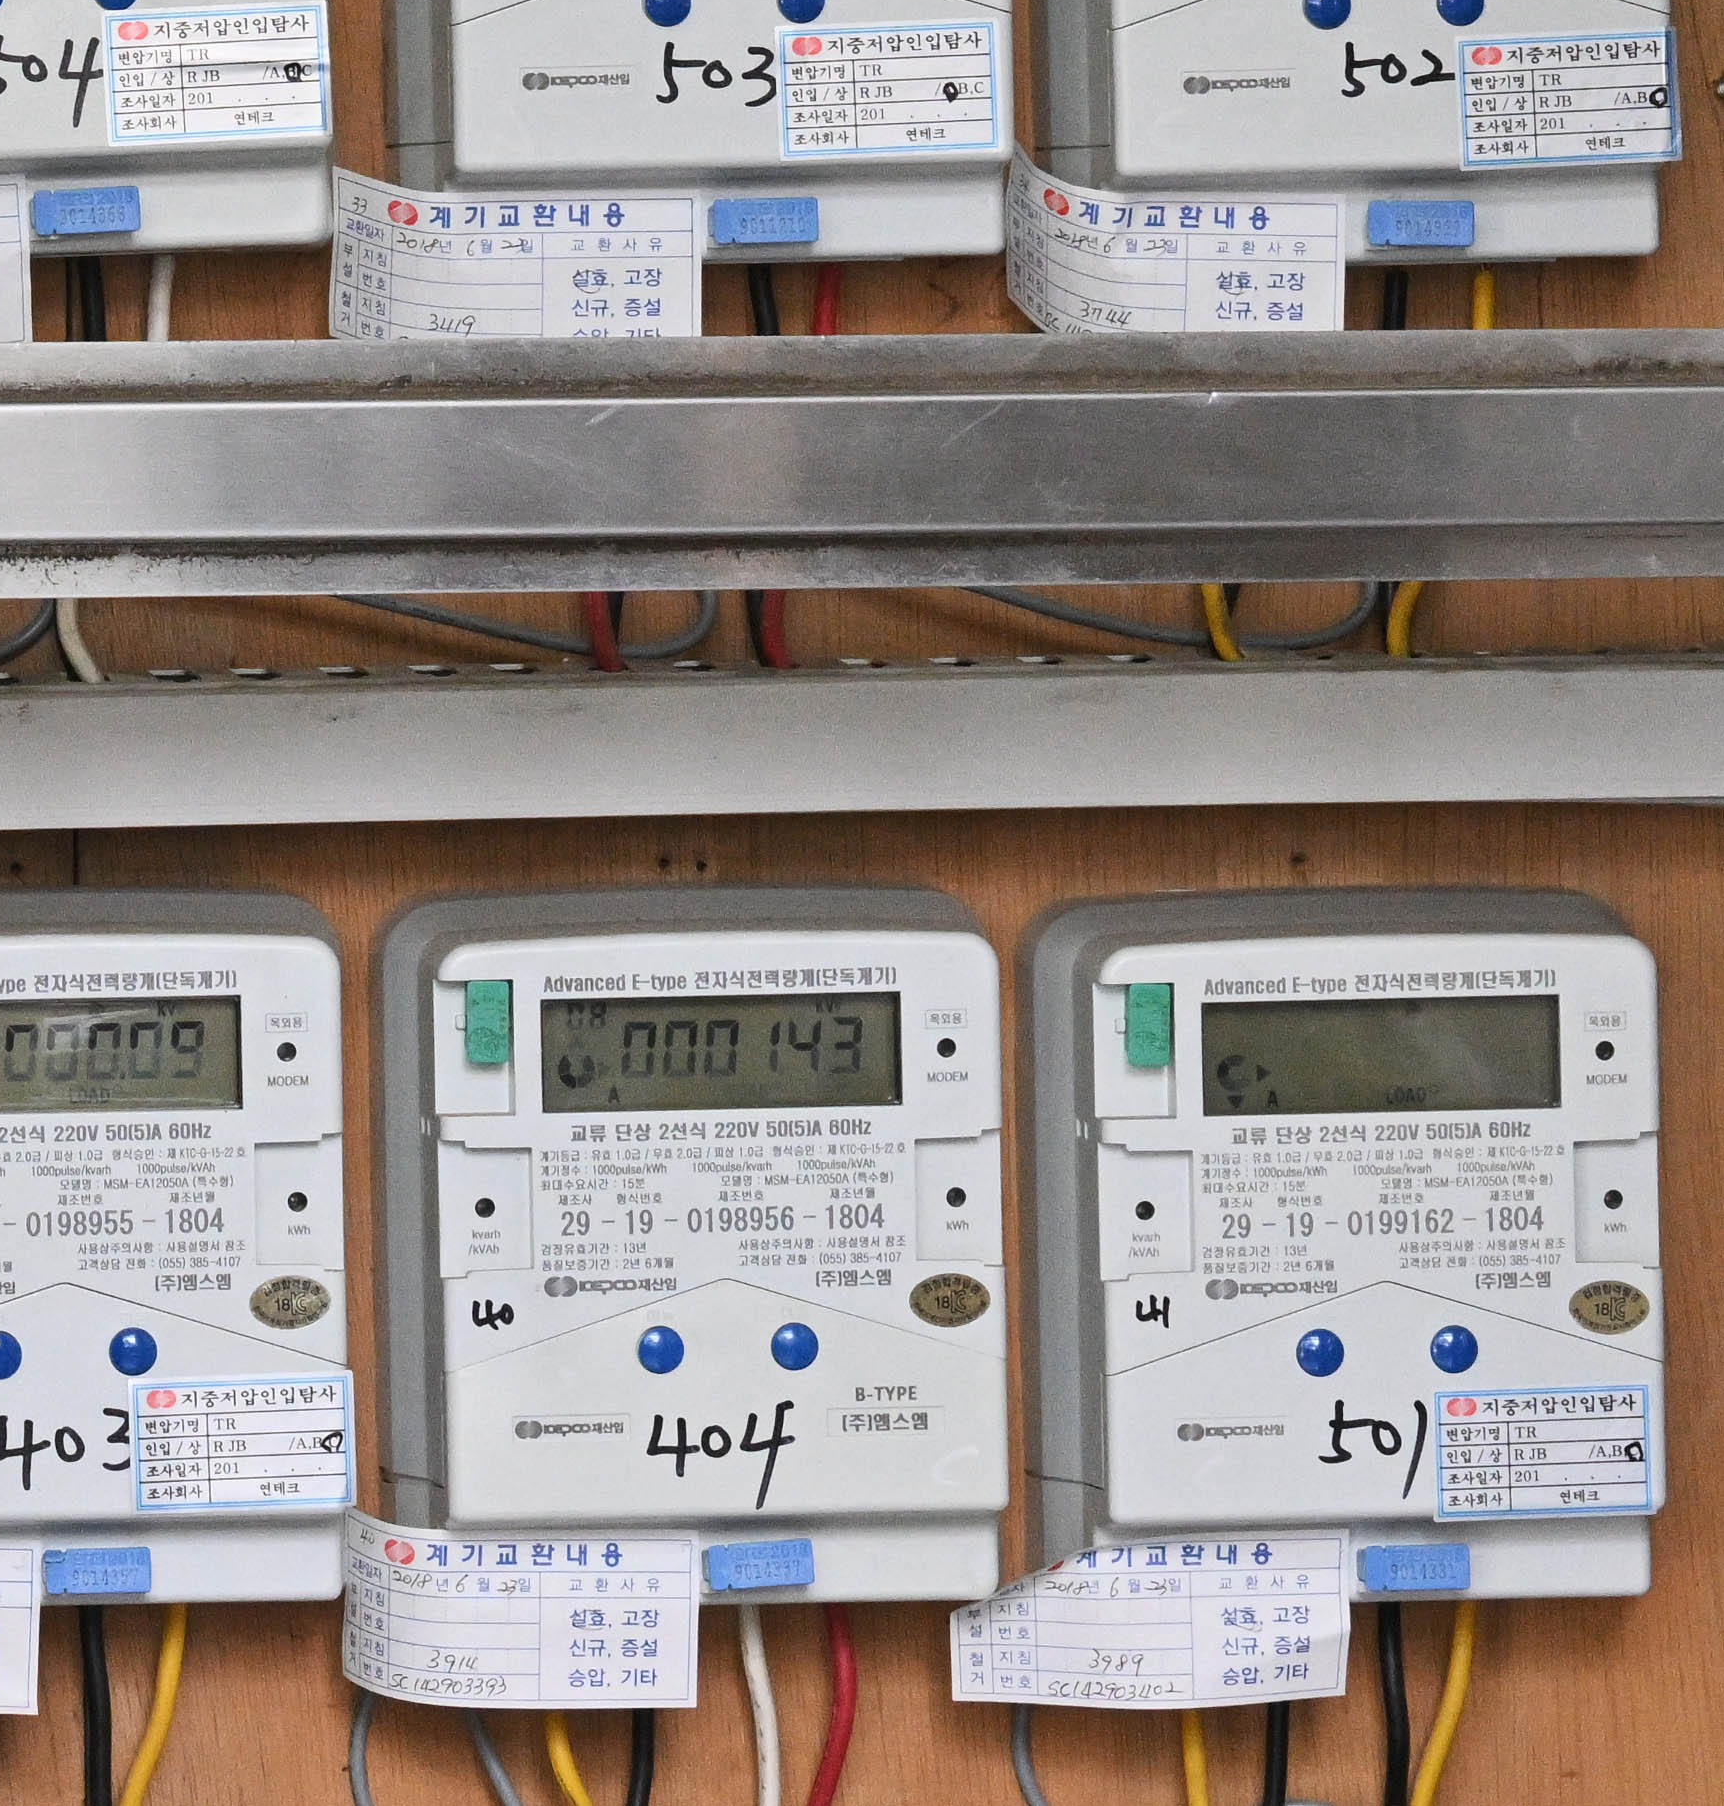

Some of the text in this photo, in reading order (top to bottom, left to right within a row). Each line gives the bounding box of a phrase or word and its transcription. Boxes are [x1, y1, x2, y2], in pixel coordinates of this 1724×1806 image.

[656, 42, 778, 107] 503
[1343, 42, 1455, 98] 502
[1204, 977, 1287, 995] Advanced
[1292, 975, 1347, 994] E-type
[571, 1124, 607, 1143] 교류
[615, 1123, 652, 1142] 단상
[659, 1122, 706, 1141] 2선식
[714, 1121, 759, 1139] 220V
[829, 1118, 872, 1136] 60Hz
[32, 1164, 111, 1178] 1000pulse/kvarh
[138, 1162, 215, 1178] 1000pulse/kVAh
[26, 1209, 134, 1237] 0198955
[561, 1203, 885, 1236] 29 19 0198956 1804
[1347, 1208, 1454, 1236] 0199162
[855, 1385, 918, 1403] B-TYPE
[648, 1401, 796, 1509] 404
[1319, 1401, 1427, 1499] 501
